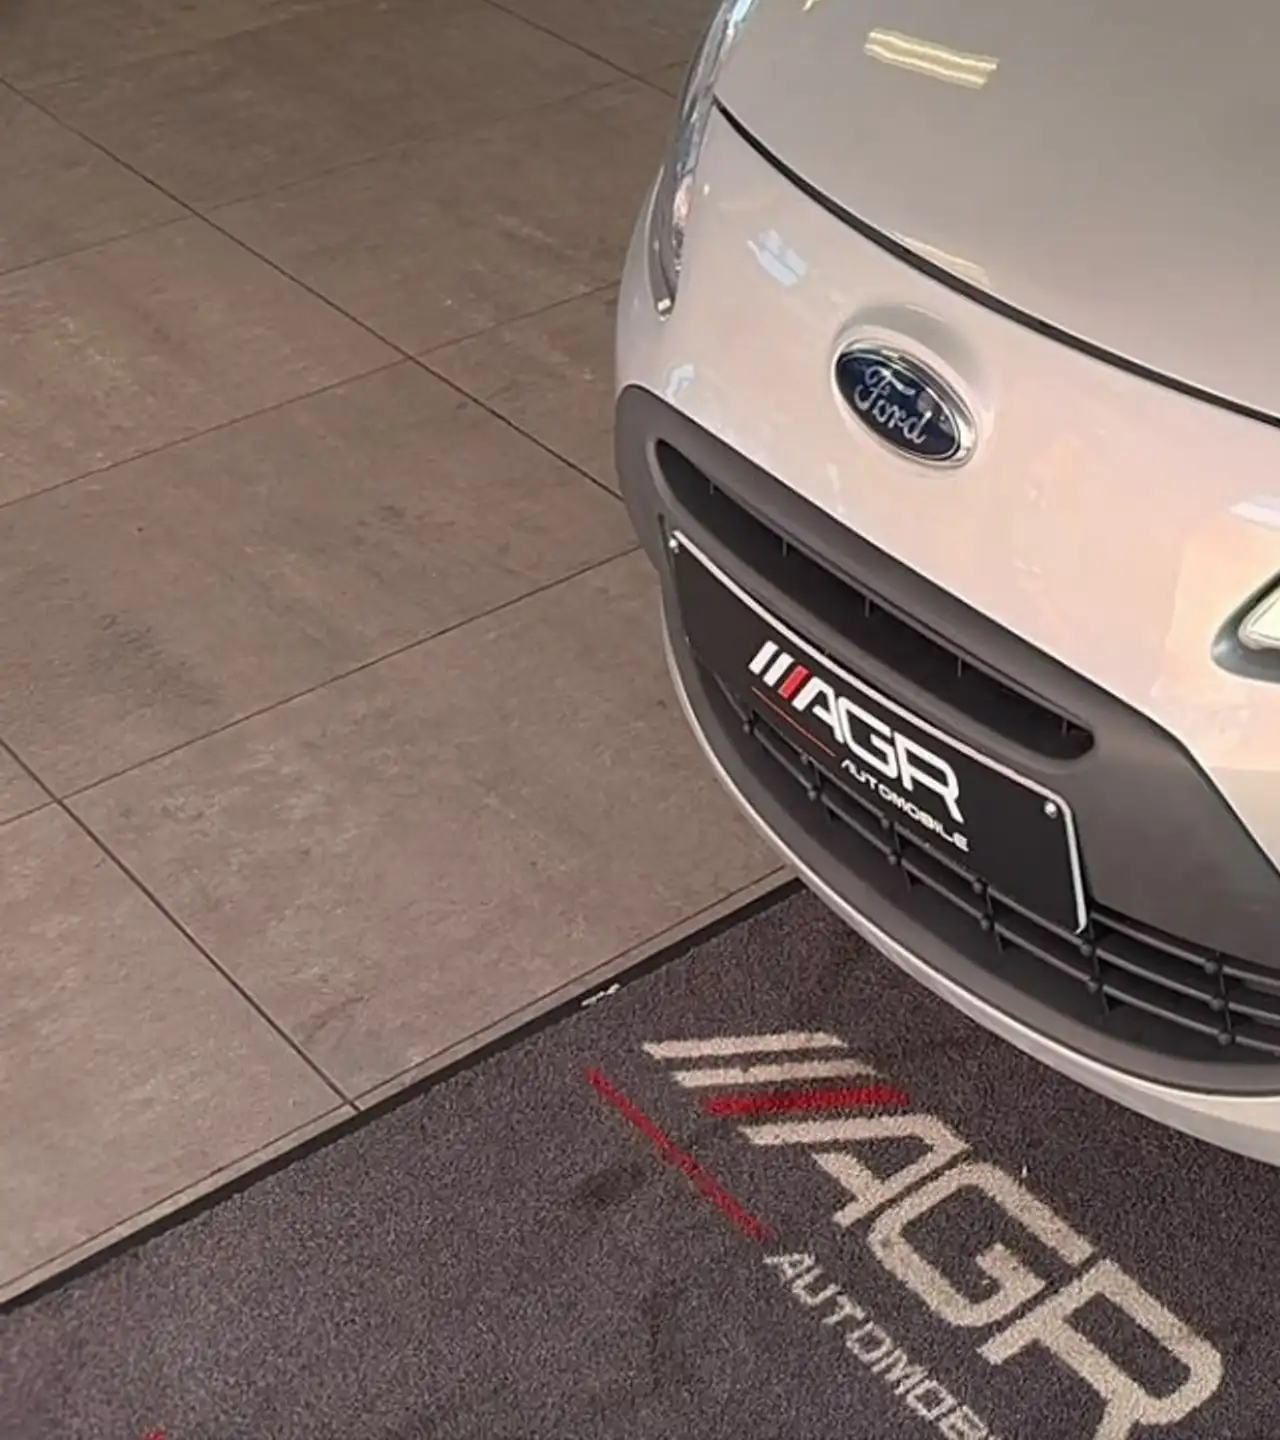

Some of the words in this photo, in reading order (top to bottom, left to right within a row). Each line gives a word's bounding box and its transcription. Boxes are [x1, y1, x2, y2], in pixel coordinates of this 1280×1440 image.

[854, 365, 927, 444] Ford
[791, 675, 965, 824] AGR
[840, 758, 970, 853] AUTOMOBILE
[762, 1252, 998, 1440] AUTOMOB
